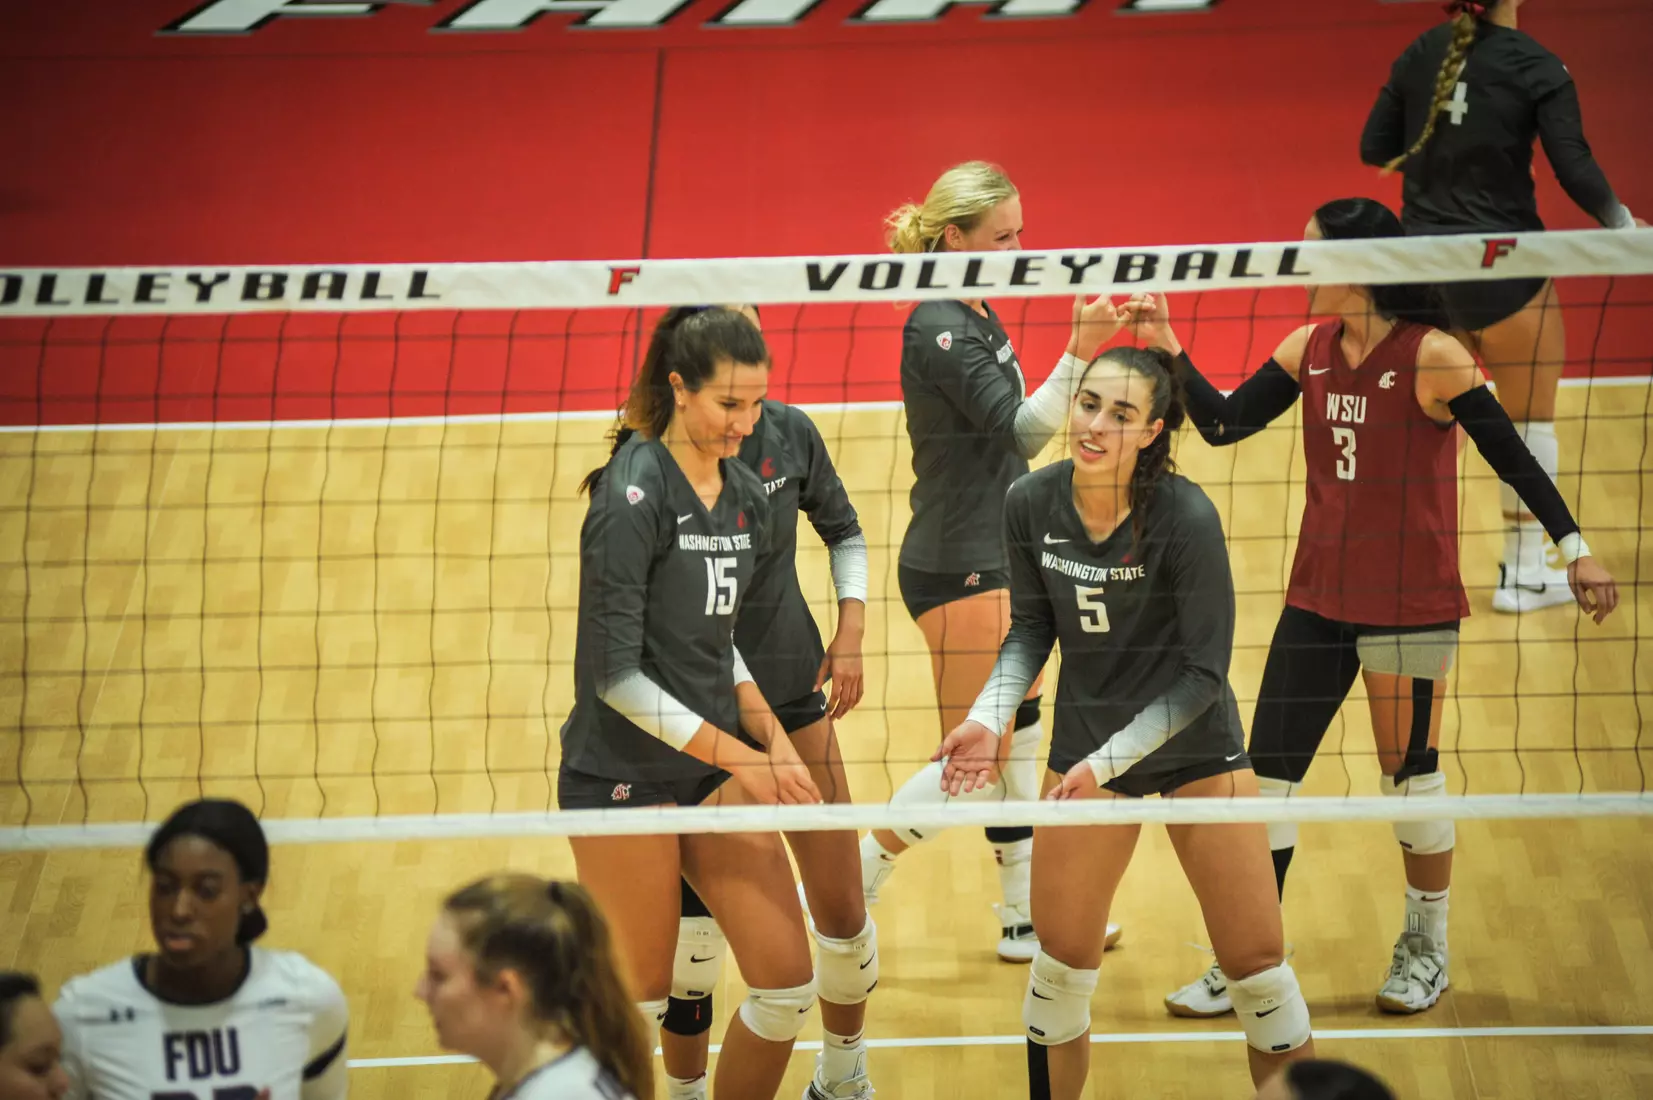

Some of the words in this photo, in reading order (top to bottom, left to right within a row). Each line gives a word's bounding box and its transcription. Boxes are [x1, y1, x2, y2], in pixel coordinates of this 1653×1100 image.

[1438, 59, 1468, 125] 4
[606, 265, 641, 296] F
[805, 246, 1312, 292] VOLLEYBALL
[1481, 237, 1517, 269] F
[1326, 392, 1367, 424] WSU
[1331, 426, 1357, 481] 3
[703, 556, 738, 616] 15
[1041, 551, 1108, 582] WASHINGTON
[1109, 564, 1146, 581] STATE
[1075, 584, 1111, 633] 5
[162, 1026, 242, 1082] FDU
